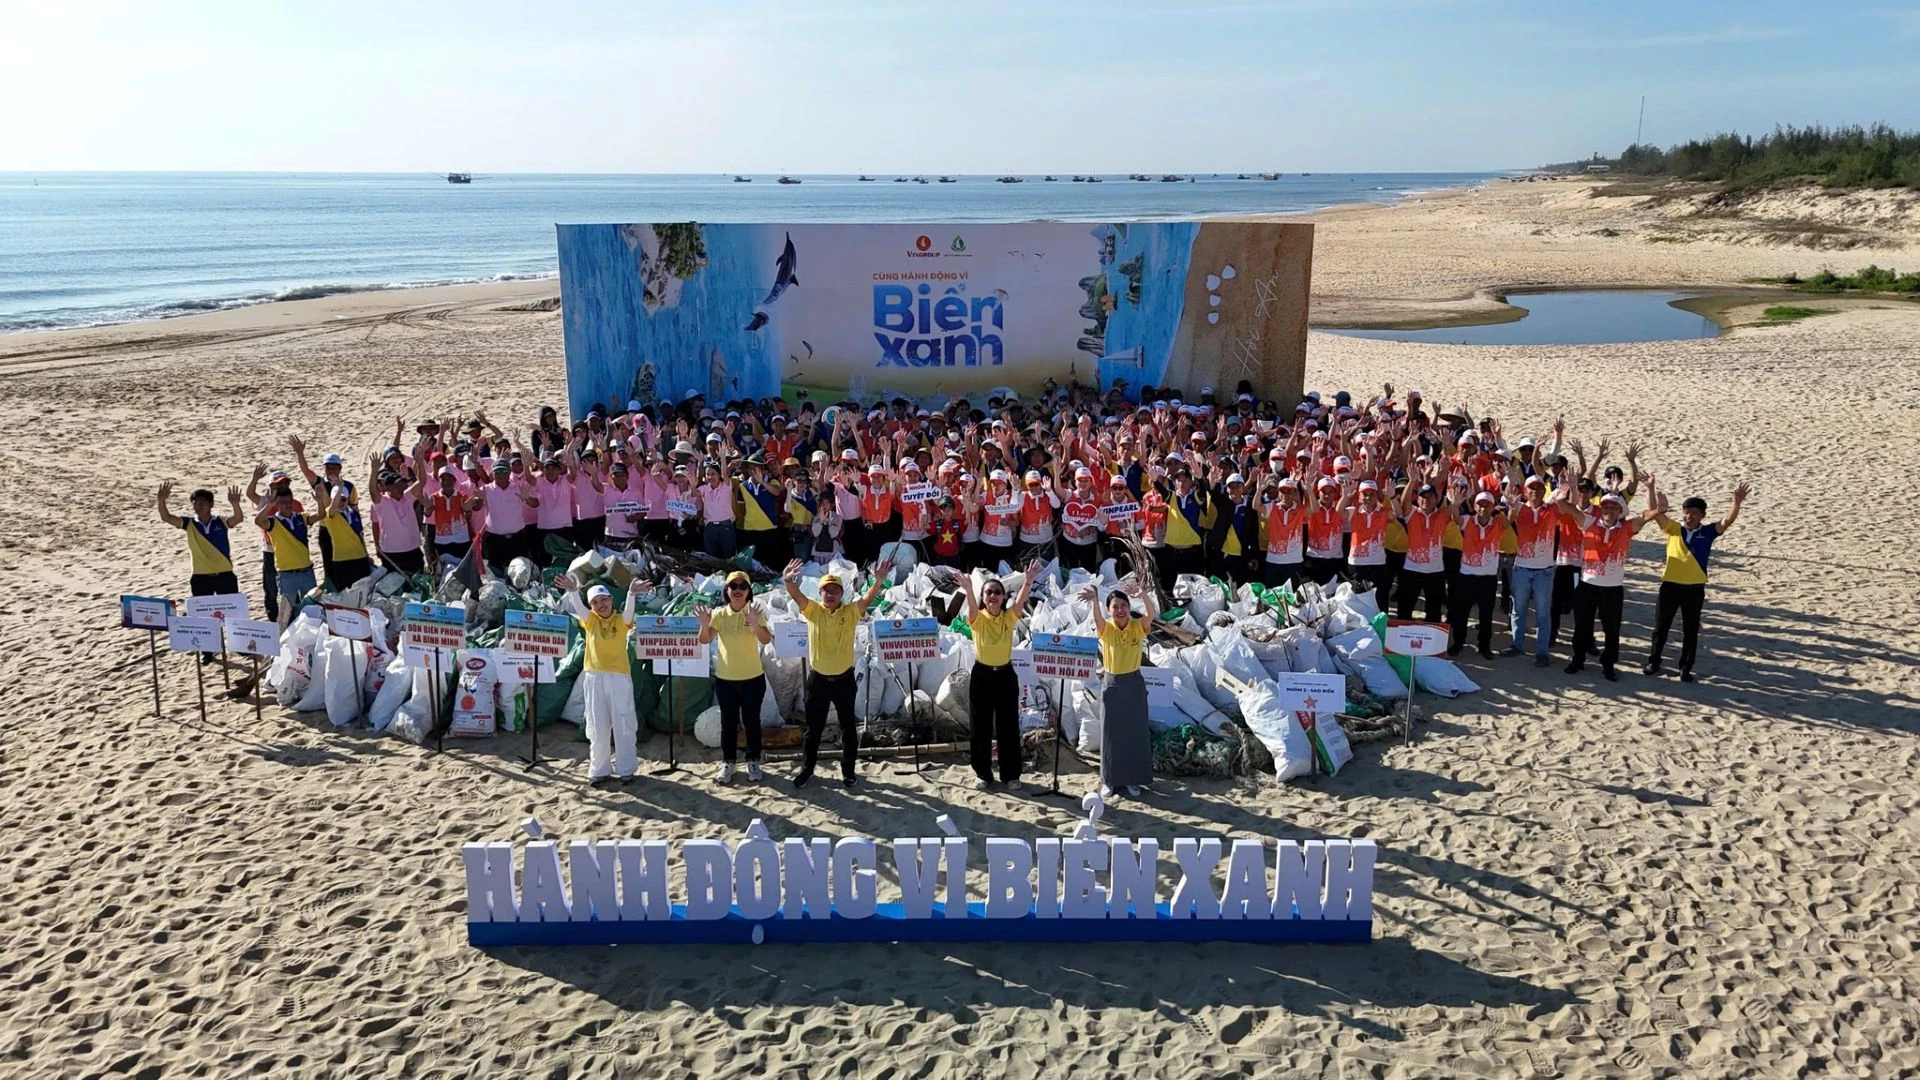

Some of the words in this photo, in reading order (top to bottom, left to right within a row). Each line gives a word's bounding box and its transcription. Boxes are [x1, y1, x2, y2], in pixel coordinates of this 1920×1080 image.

[873, 271, 899, 281] CÙNG
[901, 271, 928, 281] HÀNH
[930, 271, 957, 282] ĐỘNG
[959, 271, 969, 281] VÌ
[873, 283, 1004, 334] Biển
[874, 325, 1004, 367] xanh
[903, 492, 925, 501] TUYỆT
[639, 637, 677, 646] VINPEARL
[680, 637, 699, 646] GOLF
[879, 639, 937, 650] VINWONDERS
[645, 648, 663, 657] NAM
[666, 646, 680, 658] HỘI
[682, 648, 694, 656] AN
[883, 651, 903, 660] NAM
[905, 649, 920, 660] HỘI
[923, 649, 935, 658] AN
[1082, 658, 1095, 668] GOLF
[1036, 665, 1056, 675] NAM
[1077, 669, 1090, 678] AN
[462, 817, 671, 922] HÀNH
[683, 818, 878, 945] ĐỘNG
[893, 813, 968, 920] VÌ
[985, 791, 1160, 920] BIỂN
[1170, 838, 1377, 920] XANH
